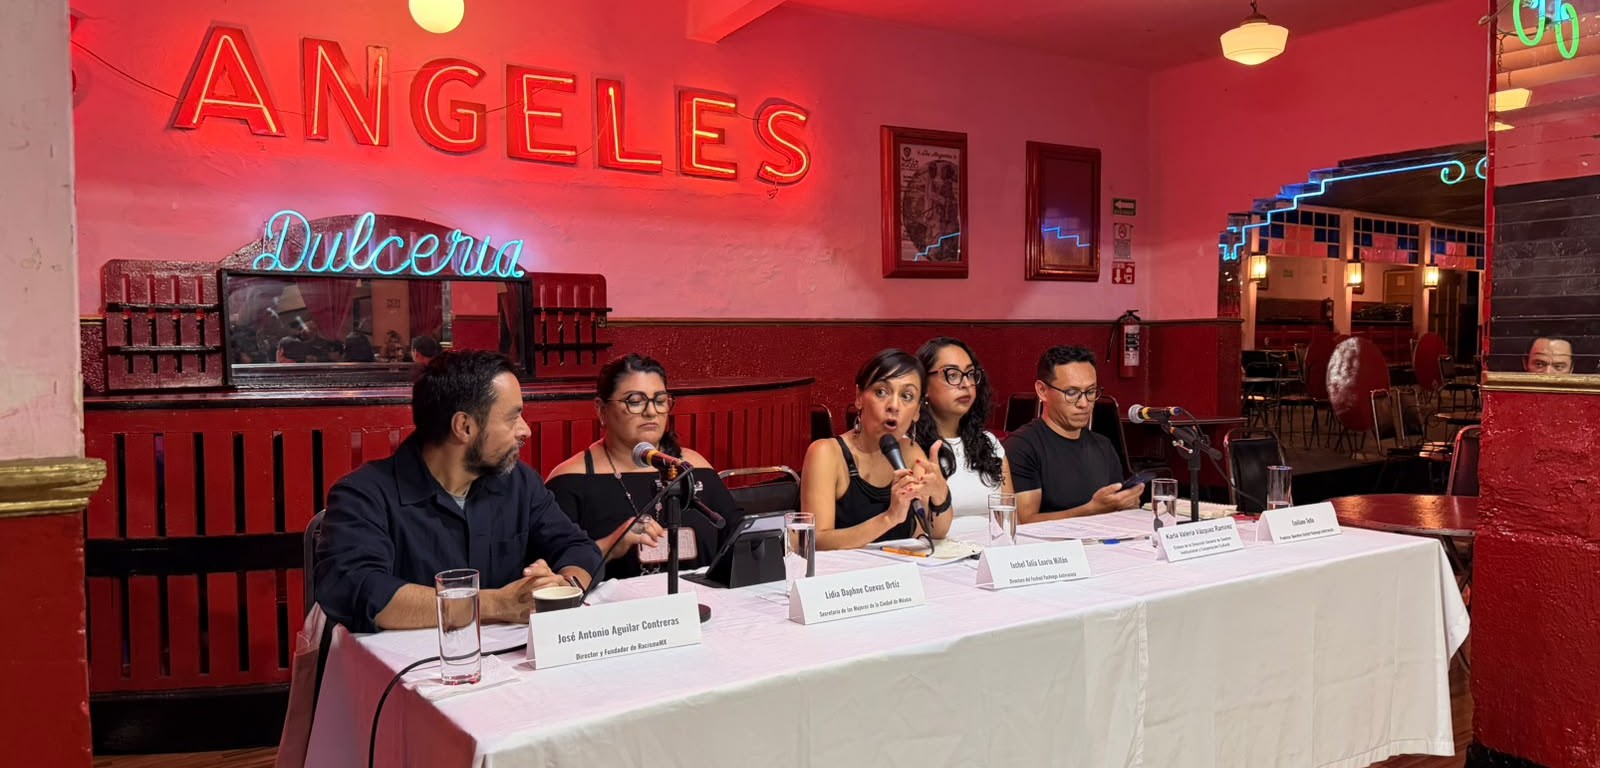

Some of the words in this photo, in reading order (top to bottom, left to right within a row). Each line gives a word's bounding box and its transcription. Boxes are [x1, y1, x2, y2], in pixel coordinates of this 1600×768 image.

[172, 25, 811, 184] ANGELES
[252, 210, 526, 278] Dulceria
[824, 590, 840, 599] Lidia
[841, 587, 863, 597] Daphne
[864, 583, 885, 593] Cuevas
[885, 580, 900, 589] Ortiz
[558, 632, 576, 644] José
[578, 627, 610, 640] Antonio
[612, 623, 640, 636] Aguilar
[641, 618, 680, 630] Contreras
[576, 651, 599, 660] Director
[604, 646, 629, 655] Fundador
[638, 638, 667, 649] RacismoMX
